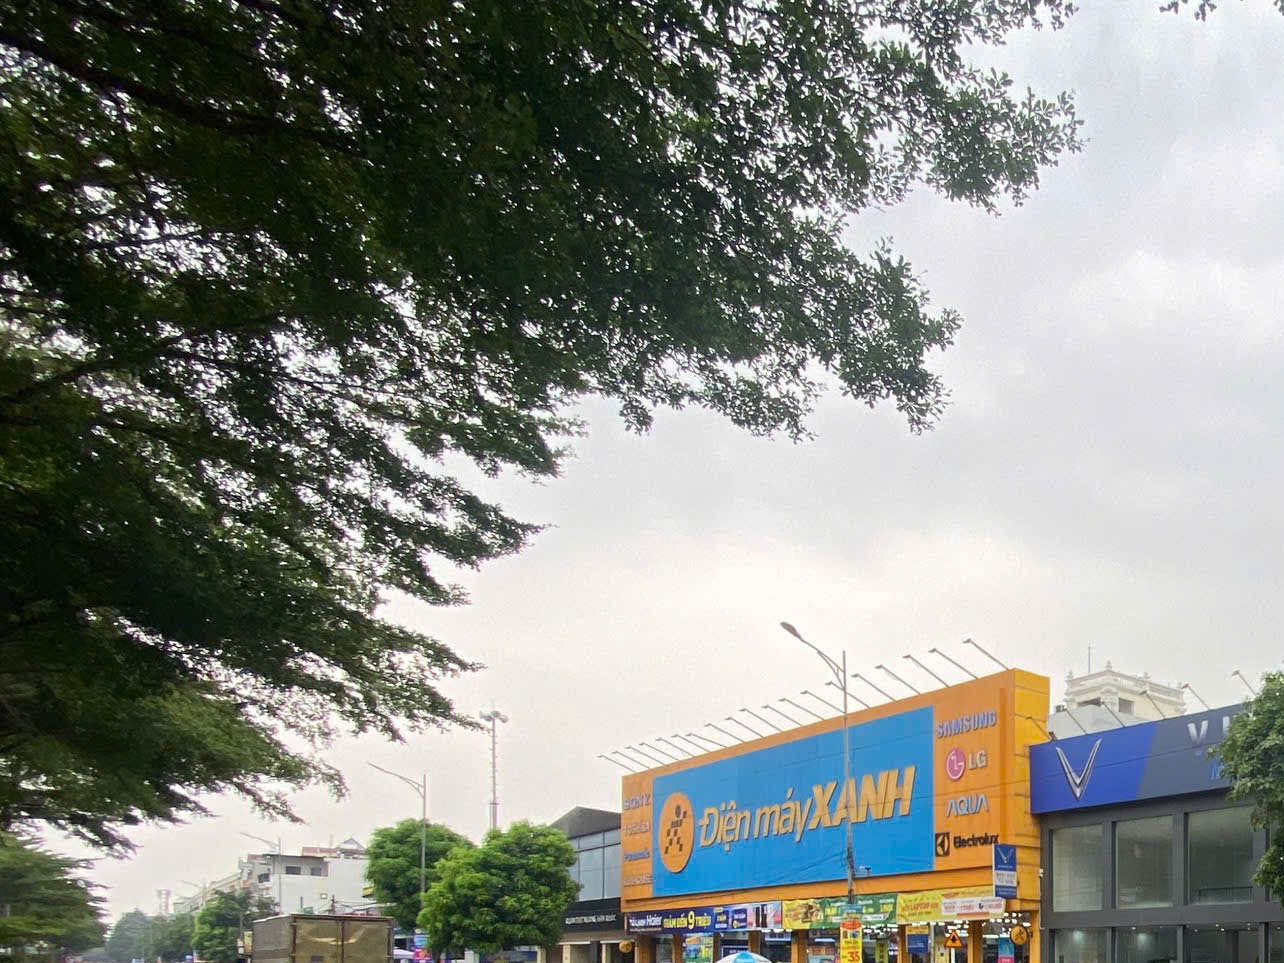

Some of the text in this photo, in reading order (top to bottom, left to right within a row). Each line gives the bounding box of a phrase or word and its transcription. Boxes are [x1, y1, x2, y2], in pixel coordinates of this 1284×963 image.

[936, 710, 997, 739] SAMSUNG
[968, 749, 987, 770] LG
[699, 799, 750, 852] Điện
[808, 765, 917, 831] XANH
[946, 792, 989, 817] AQUA
[953, 832, 1000, 849] Electrolux
[646, 914, 662, 926] Haier
[688, 910, 695, 930] 9
